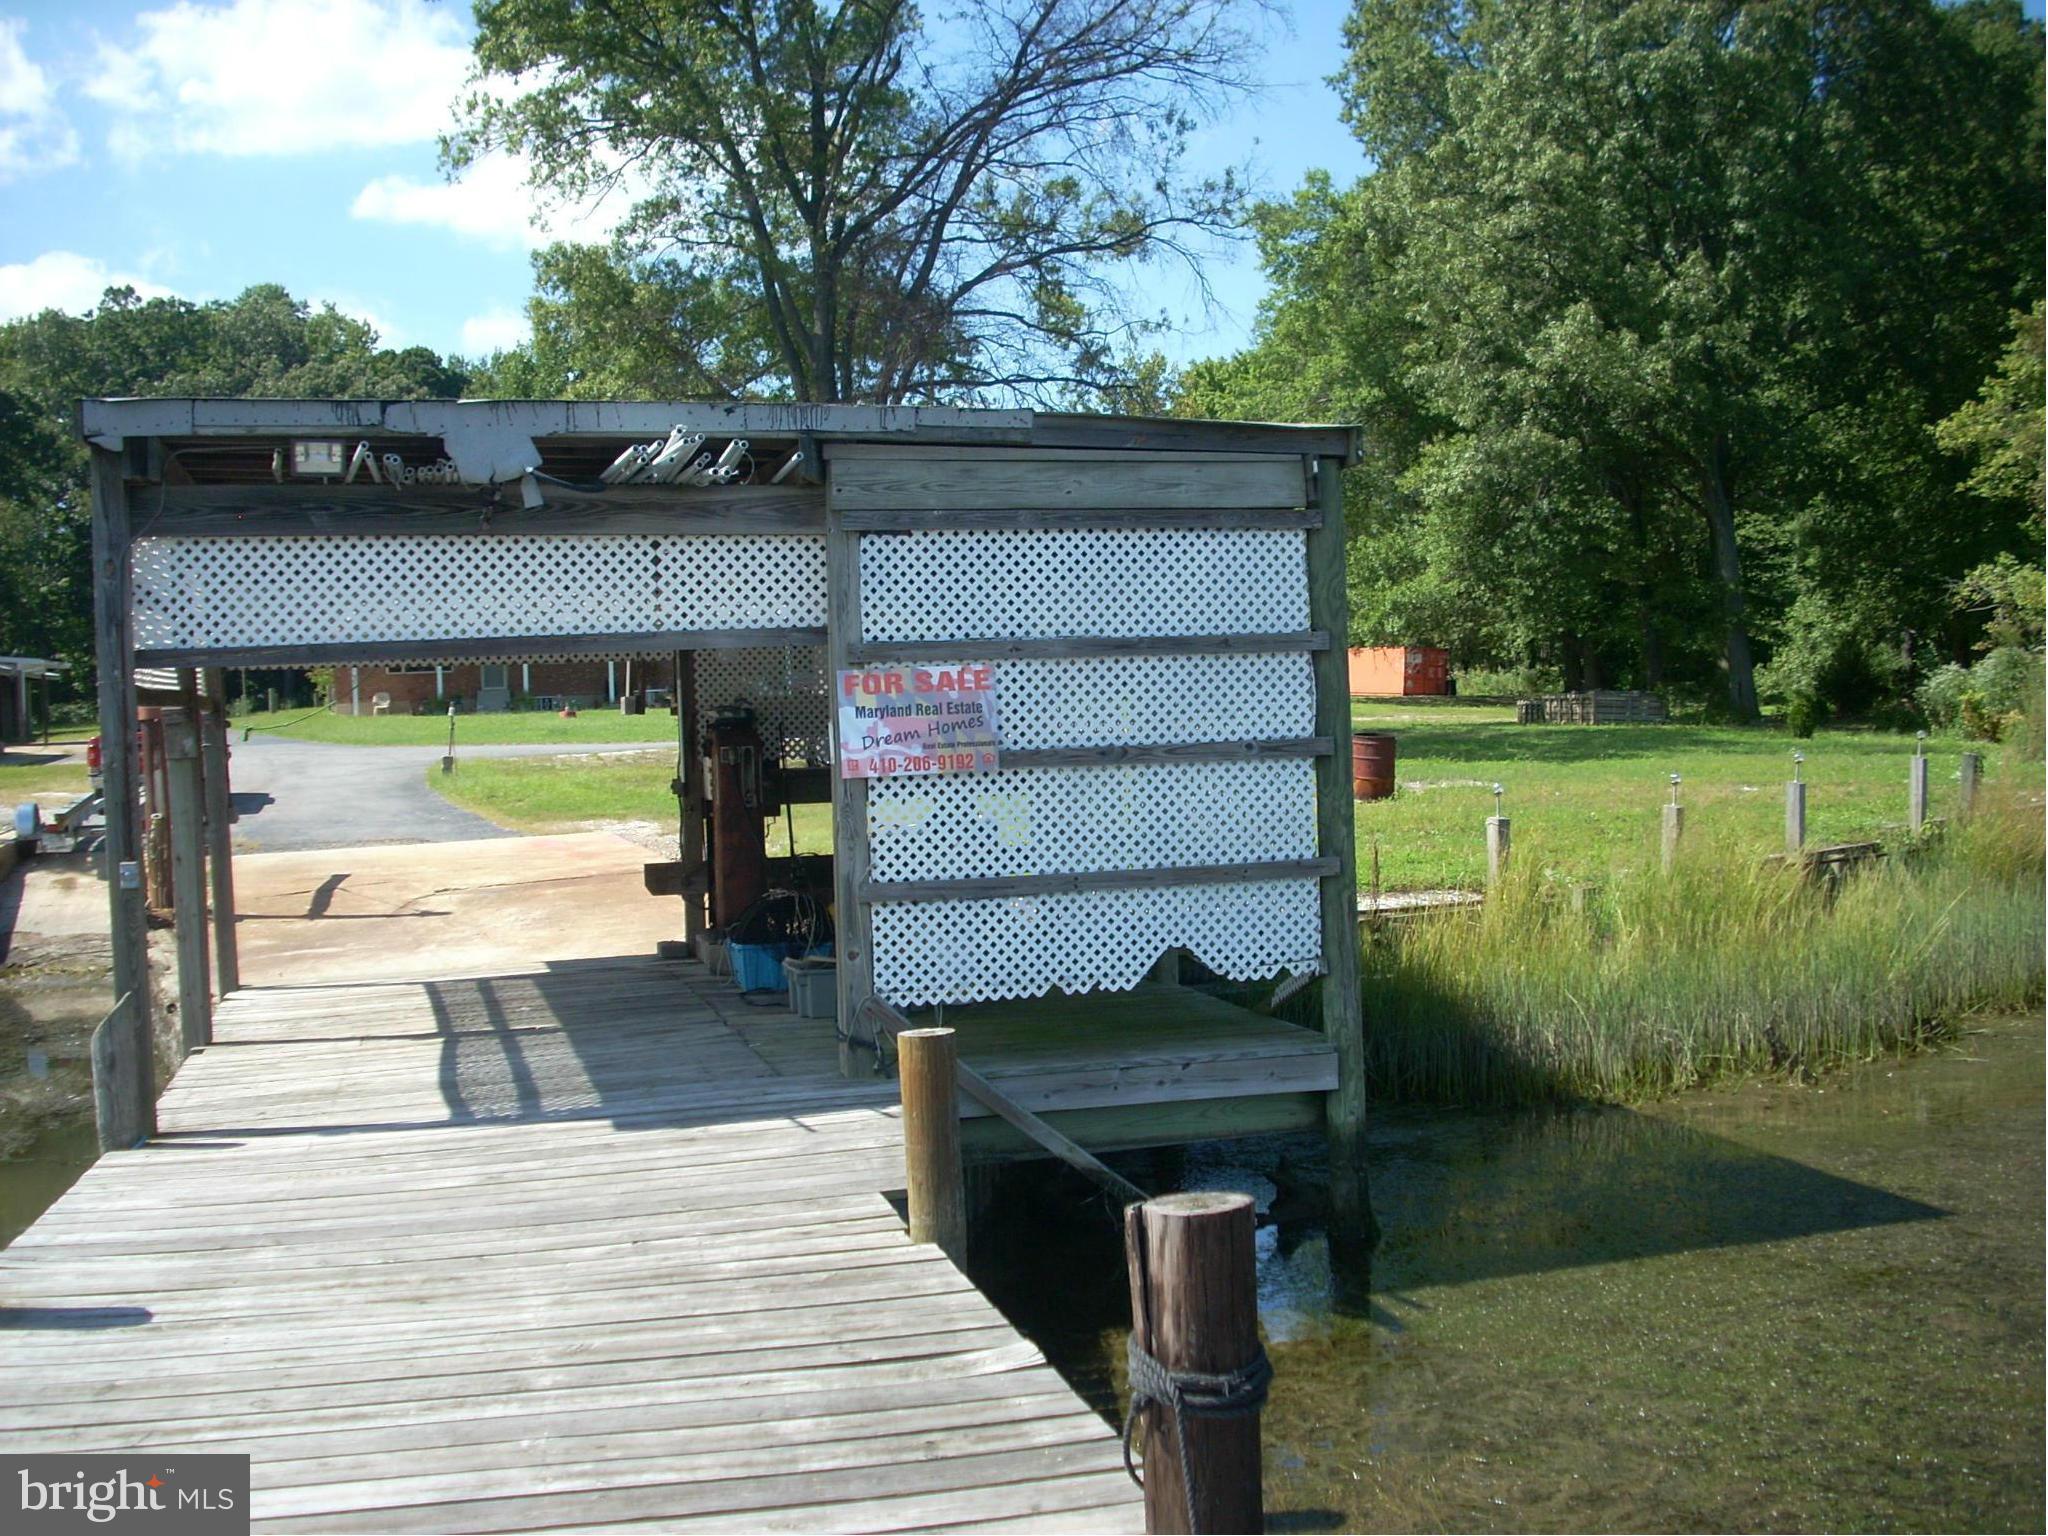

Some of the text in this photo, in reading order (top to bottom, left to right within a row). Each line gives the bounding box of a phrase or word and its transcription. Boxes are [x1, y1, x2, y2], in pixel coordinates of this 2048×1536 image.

[843, 666, 993, 697] FOR SALE
[855, 702, 983, 719] Maryland Real Estate
[862, 715, 984, 751] Dream Homes
